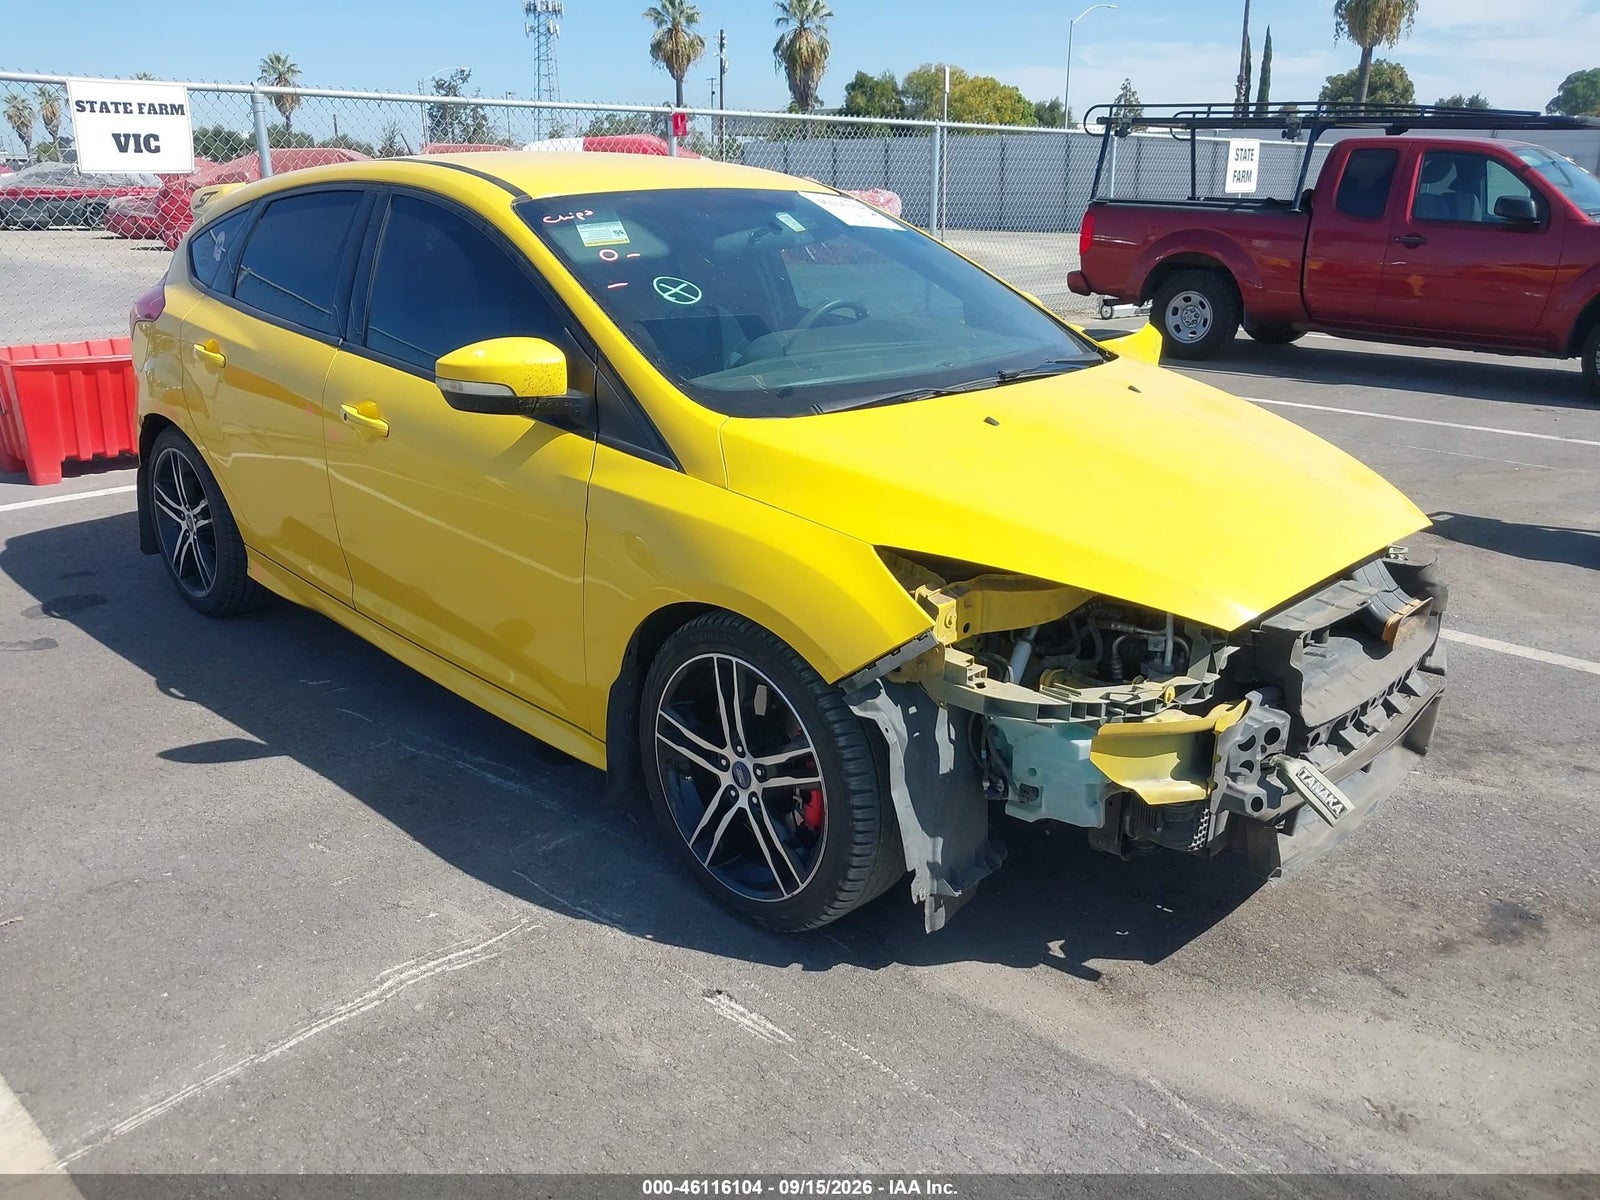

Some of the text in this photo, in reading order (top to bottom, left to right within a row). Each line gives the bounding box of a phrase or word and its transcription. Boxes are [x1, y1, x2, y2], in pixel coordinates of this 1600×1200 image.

[74, 99, 186, 116] STATE FARM
[111, 133, 161, 154] VIC
[1234, 148, 1255, 162] STATE
[1232, 169, 1253, 183] FARM
[1298, 769, 1345, 817] TANAKA
